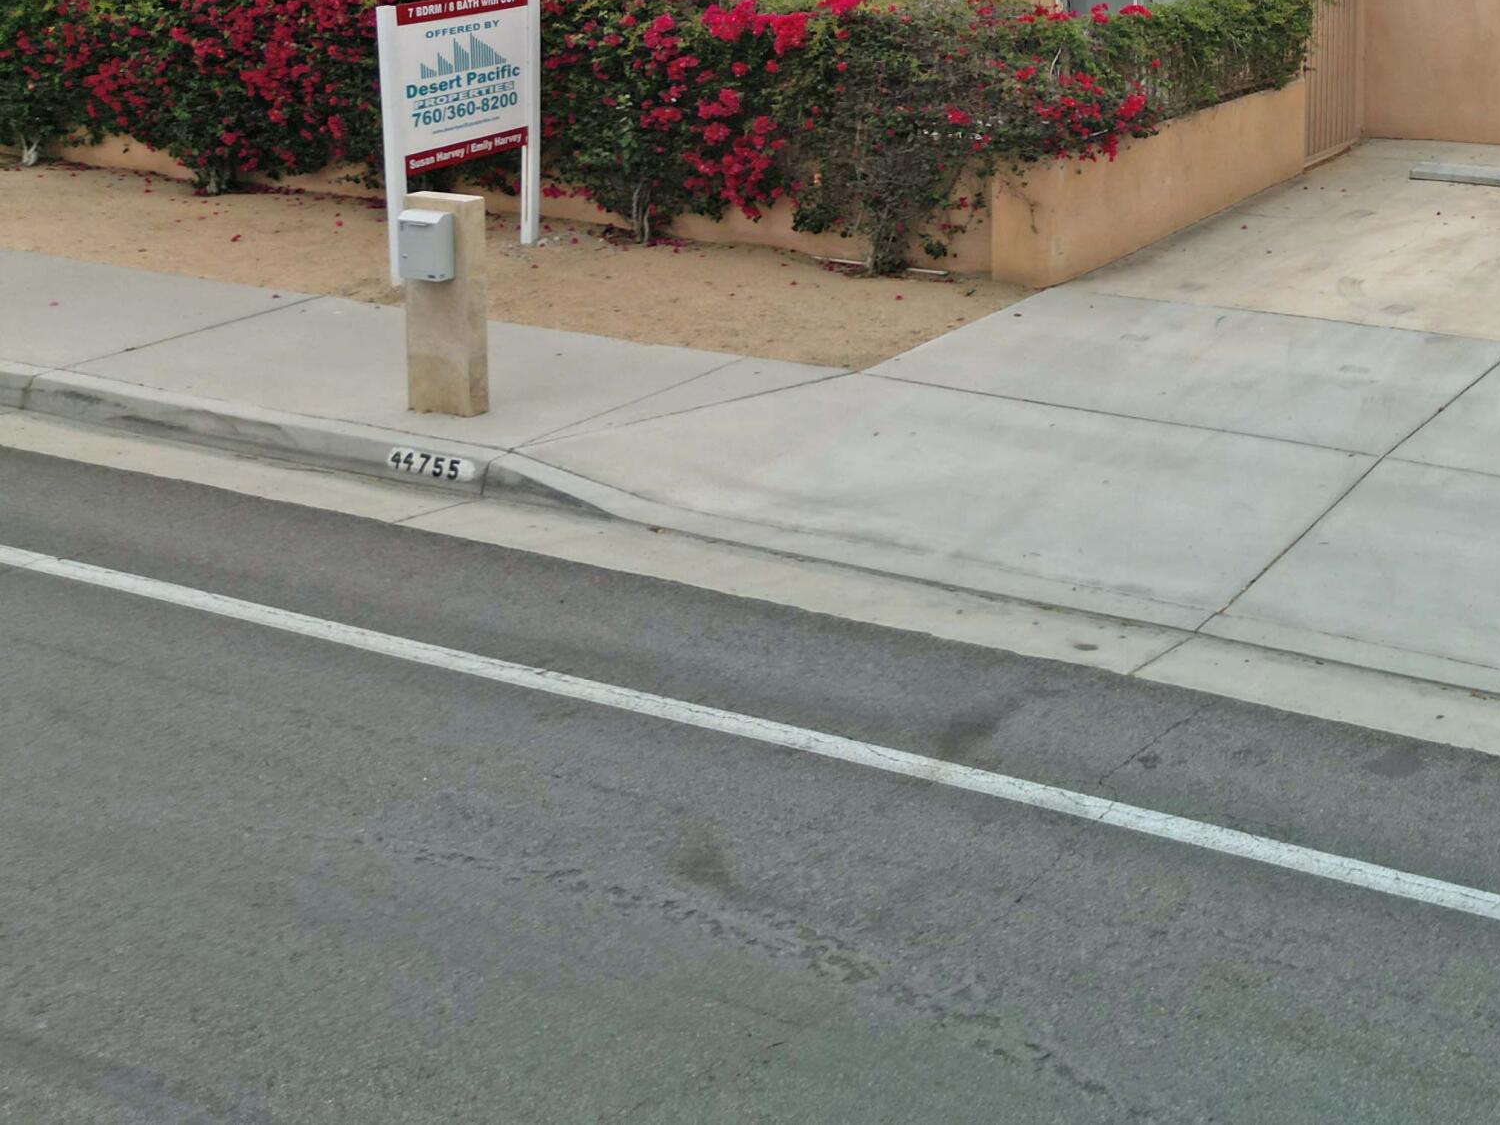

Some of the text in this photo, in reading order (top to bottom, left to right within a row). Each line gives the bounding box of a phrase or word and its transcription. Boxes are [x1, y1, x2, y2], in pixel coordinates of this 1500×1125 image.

[408, 8, 414, 18] 7
[416, 4, 442, 17] BDRM
[449, 2, 455, 11] 8
[456, 0, 479, 10] BATH
[425, 19, 500, 39] OFFERED BY
[406, 64, 521, 99] Desert Pacific
[415, 81, 515, 110] PROPERTIES
[412, 91, 518, 128] 760/360-8200
[409, 156, 435, 169] Susan
[436, 148, 465, 163] Harvey
[471, 140, 493, 153] Emily
[494, 133, 522, 146] Harvey
[391, 451, 461, 480] 44755
